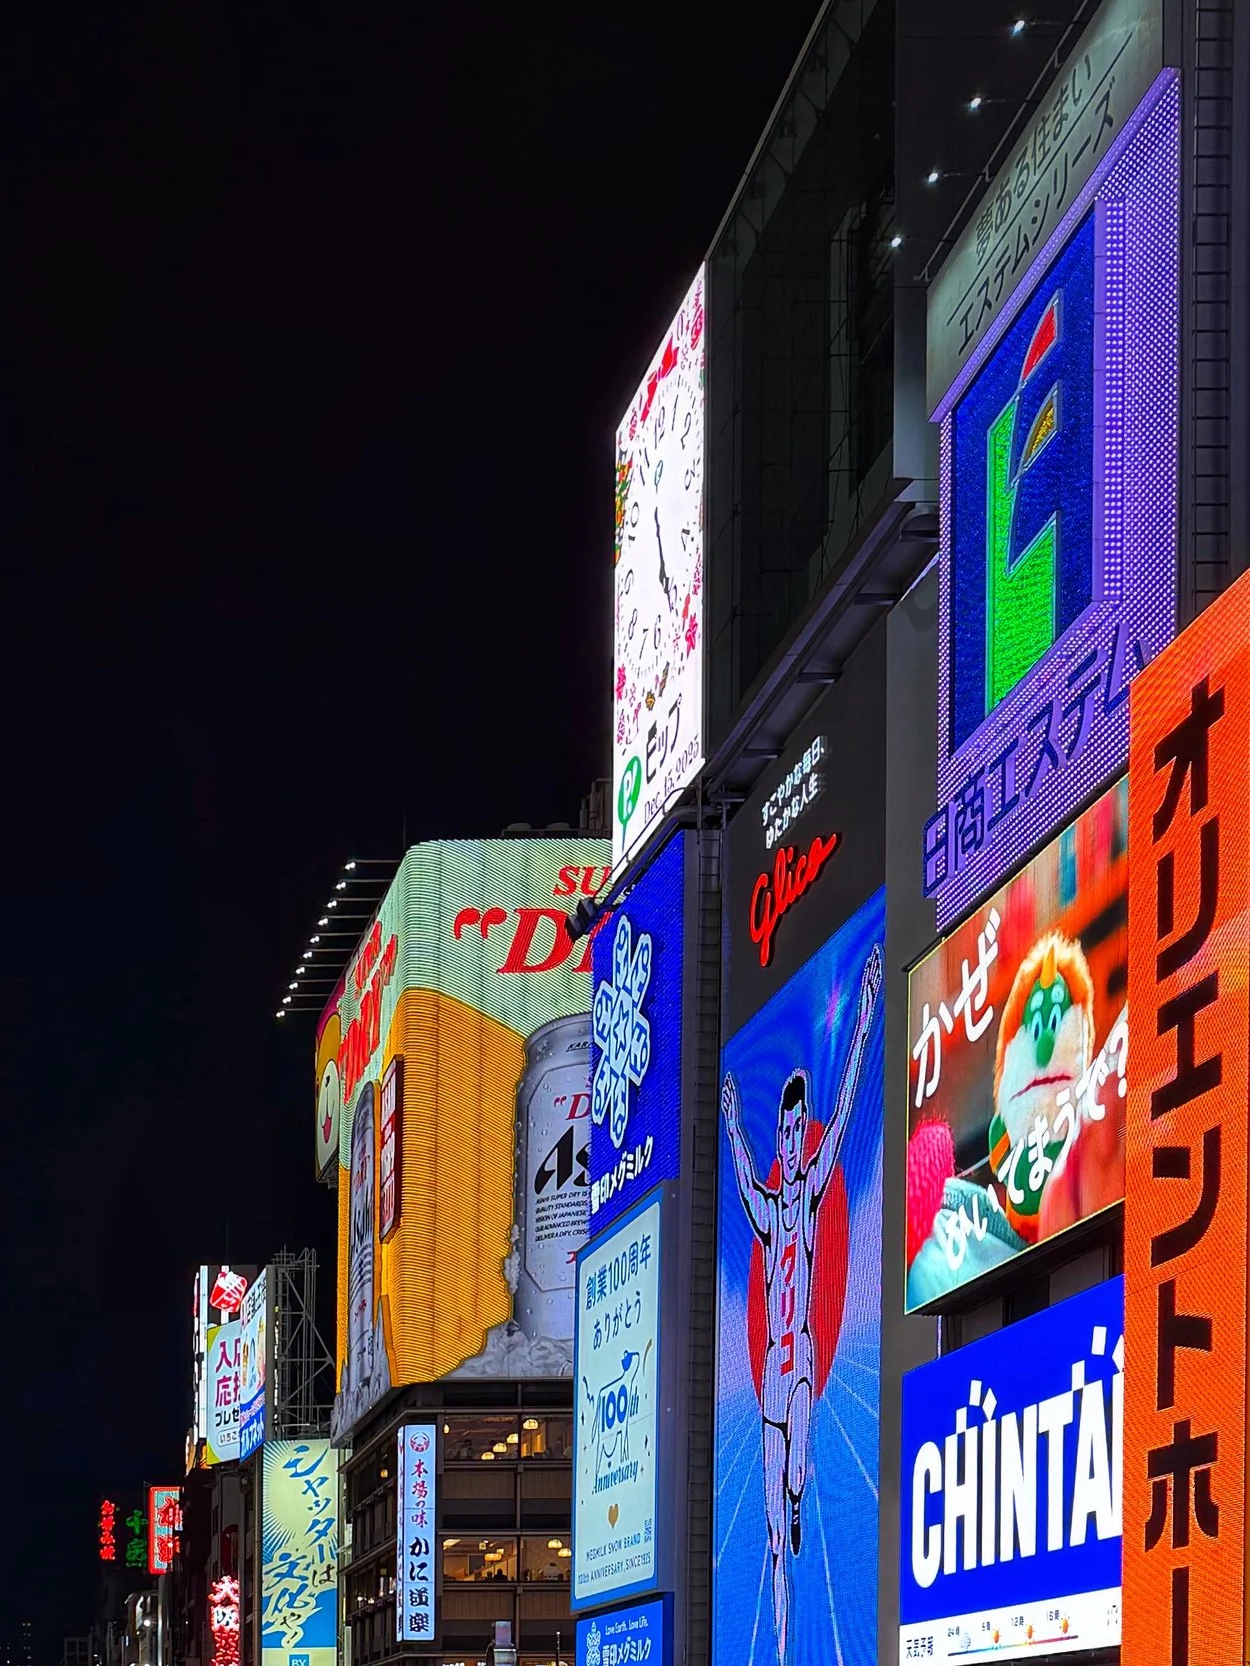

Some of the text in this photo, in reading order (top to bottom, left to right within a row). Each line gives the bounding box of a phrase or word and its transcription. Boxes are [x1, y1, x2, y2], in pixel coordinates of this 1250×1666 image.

[957, 75, 1116, 356] エステムシリーズ
[750, 834, 838, 967] Glico
[912, 906, 1001, 1109] かぜ
[591, 1137, 654, 1215] 雪印メグミルク
[586, 1233, 652, 1311] 創業100周年
[780, 1232, 797, 1377] グリコ
[592, 1300, 644, 1350] ありがとう
[411, 1459, 428, 1528] 本場の味
[408, 1536, 431, 1634] かに道楽
[624, 1534, 641, 1549] BRAND
